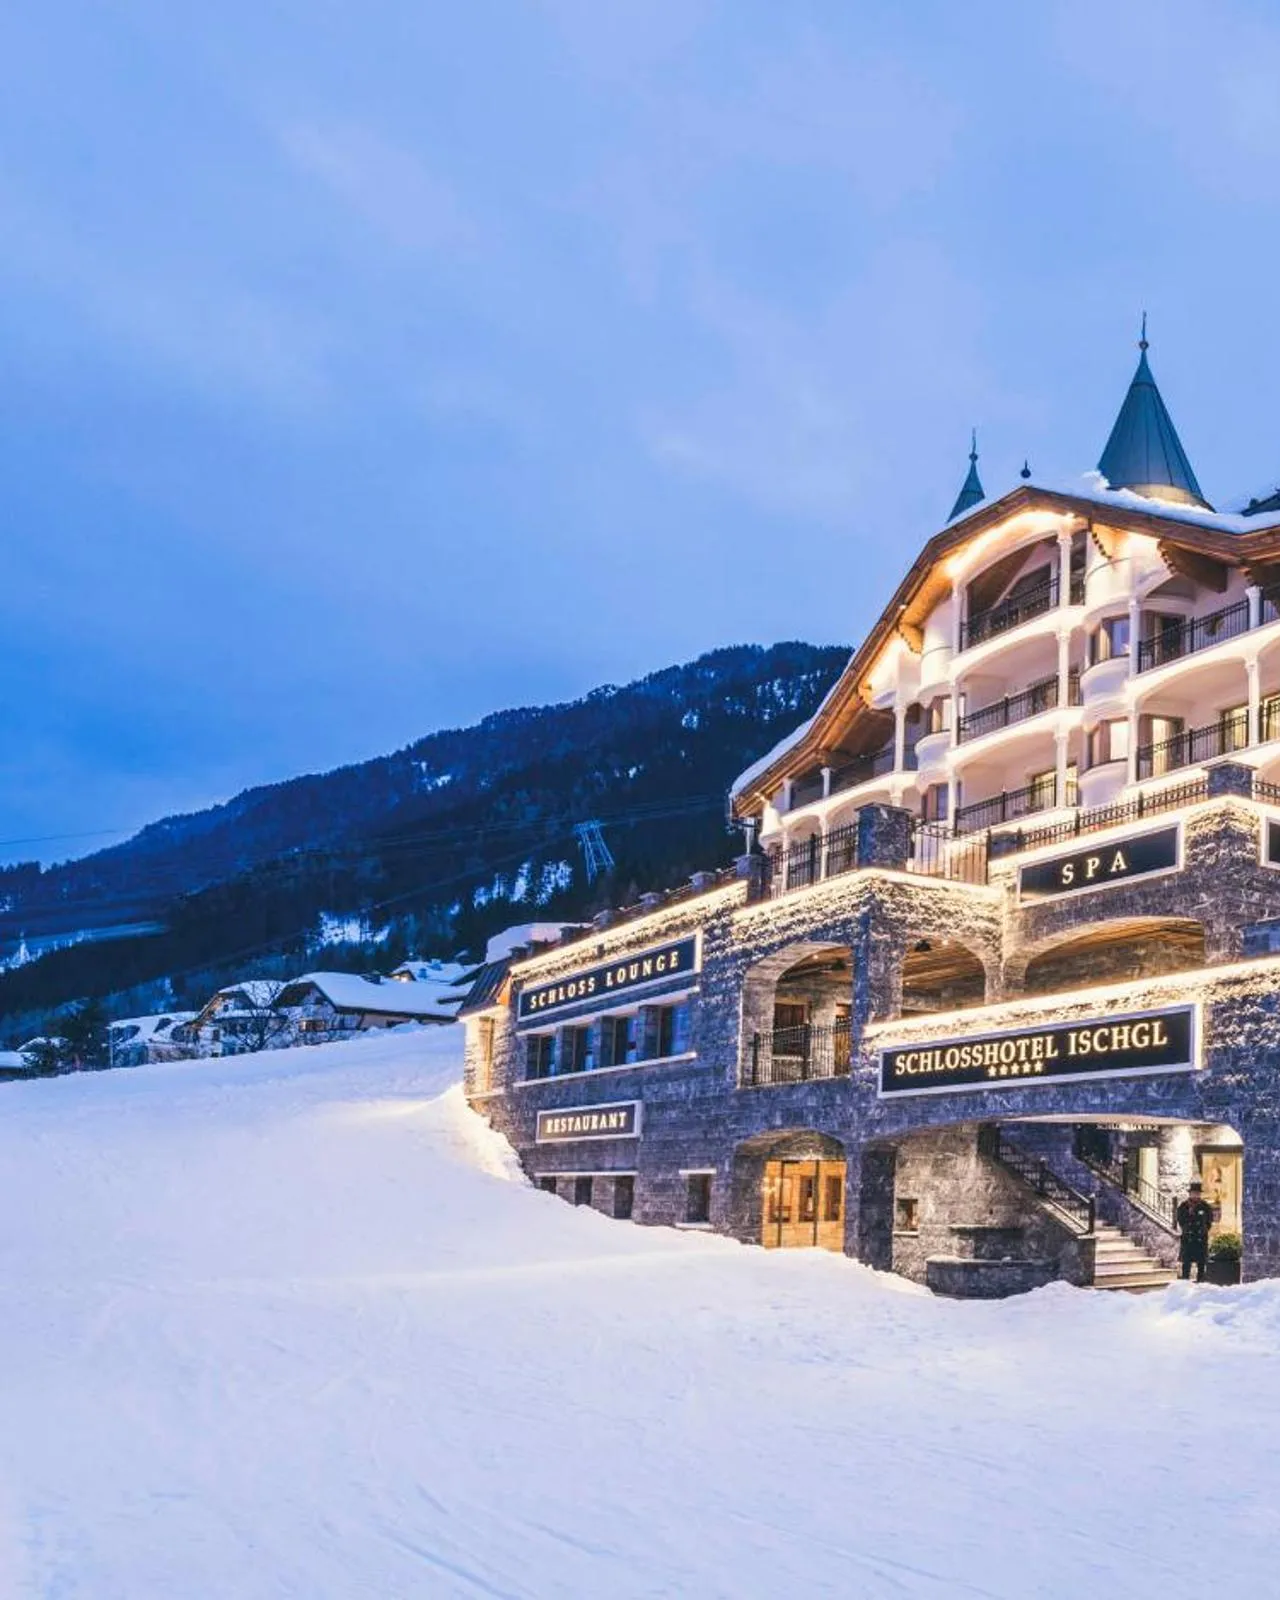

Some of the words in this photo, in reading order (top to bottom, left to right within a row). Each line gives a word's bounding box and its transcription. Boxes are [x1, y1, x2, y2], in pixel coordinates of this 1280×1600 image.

[1062, 850, 1128, 885] SPA
[530, 977, 595, 1009] SCHLOSS
[606, 951, 679, 987] LOUNGE
[895, 1035, 1058, 1075] SCHLOSSHOTEL
[1068, 1020, 1168, 1056] ISCHGL
[546, 1111, 628, 1134] RESTAURANT
